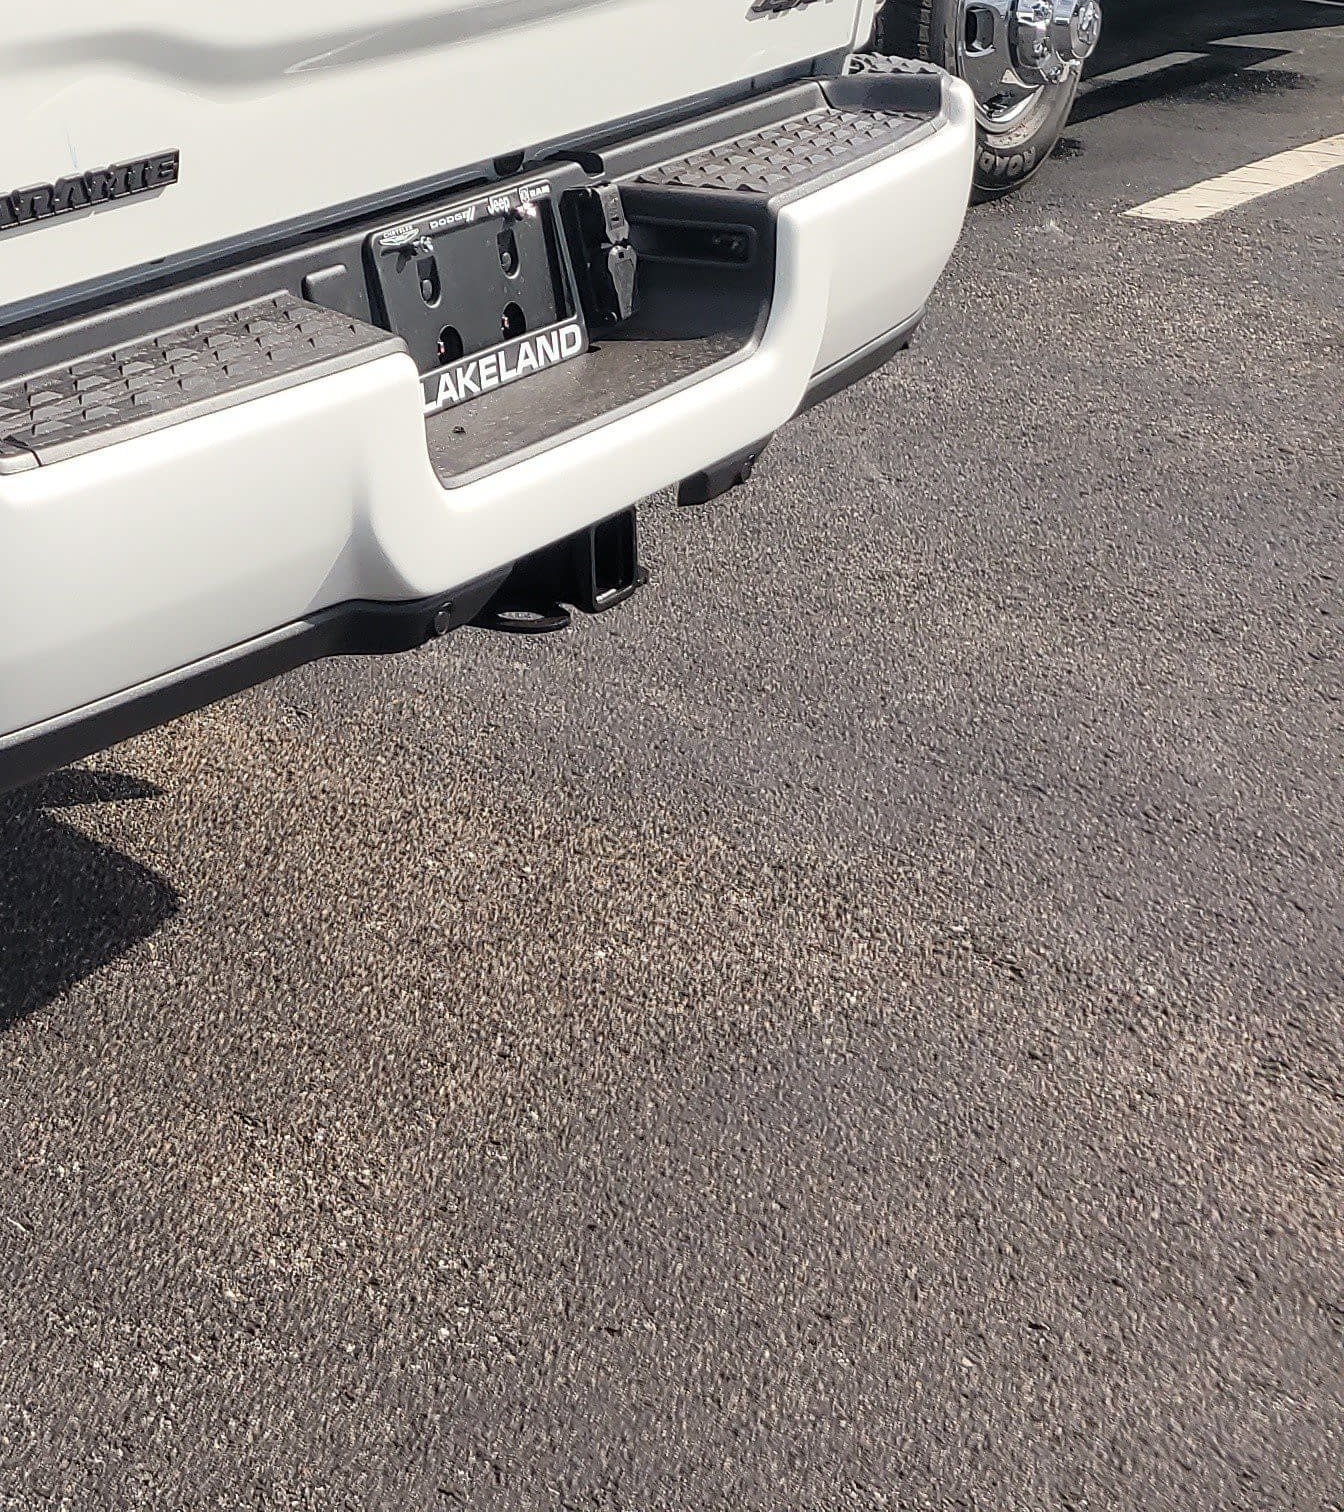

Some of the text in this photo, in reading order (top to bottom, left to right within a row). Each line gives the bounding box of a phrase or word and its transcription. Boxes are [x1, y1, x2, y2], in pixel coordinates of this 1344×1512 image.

[487, 196, 510, 215] Jeep
[529, 185, 550, 198] RAM
[420, 324, 582, 414] LAKELAND
